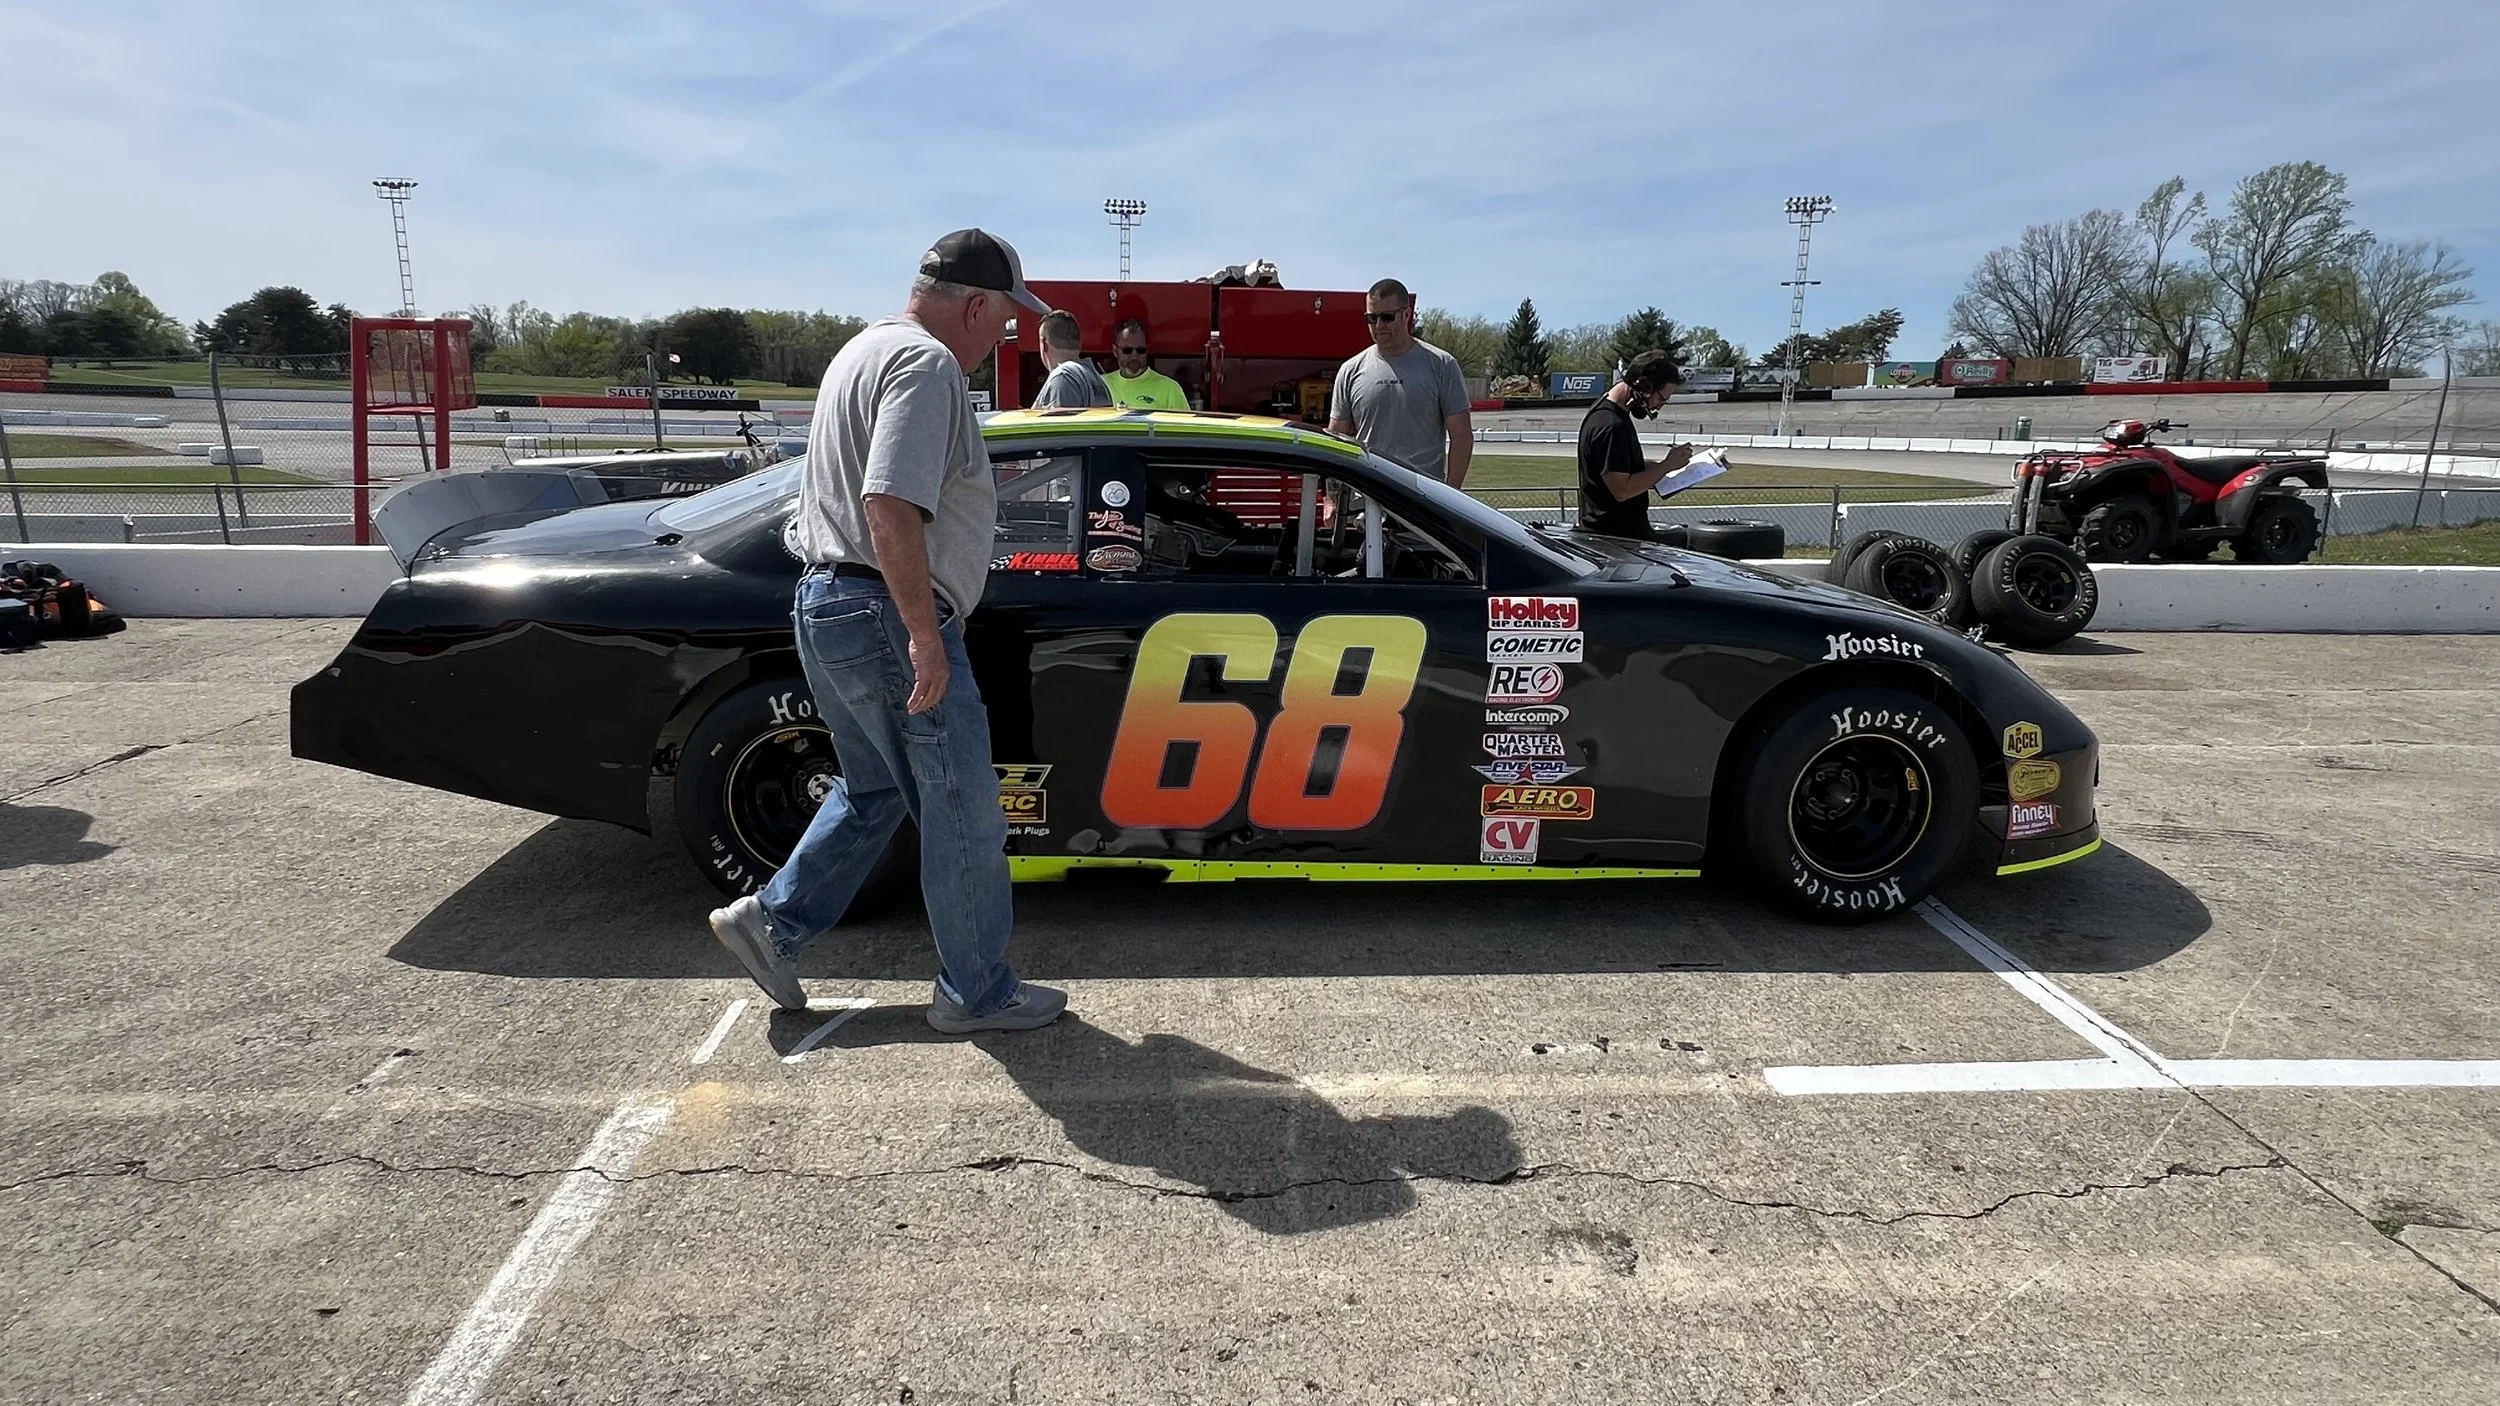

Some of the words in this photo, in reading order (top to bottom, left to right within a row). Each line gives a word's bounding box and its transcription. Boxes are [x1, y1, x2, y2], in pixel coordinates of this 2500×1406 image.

[662, 388, 737, 399] SPEEDWAY
[1088, 511, 1102, 520] The
[1884, 539, 1942, 555] Hoosier
[1008, 552, 1079, 568] KIMMEL
[1490, 598, 1576, 629] Holley
[1491, 620, 1511, 628] HP
[1513, 620, 1561, 628] CARBS
[1489, 637, 1582, 653] COMETIC
[1822, 632, 1924, 660] Hoosier
[1100, 613, 1428, 830] 68
[1485, 709, 1560, 725] Intercomp
[1829, 707, 1946, 748] Hoosier
[1485, 734, 1559, 750] QUARTER
[2007, 731, 2039, 753] ACCEL
[1498, 745, 1562, 756] MASTER
[1491, 761, 1526, 772] FIVE
[1531, 761, 1565, 774] STAR
[1493, 788, 1578, 809] AERO
[1007, 827, 1022, 835] ark
[1024, 826, 1050, 836] Plugs
[1485, 821, 1536, 850] CV
[1793, 870, 1906, 911] Hoosier
